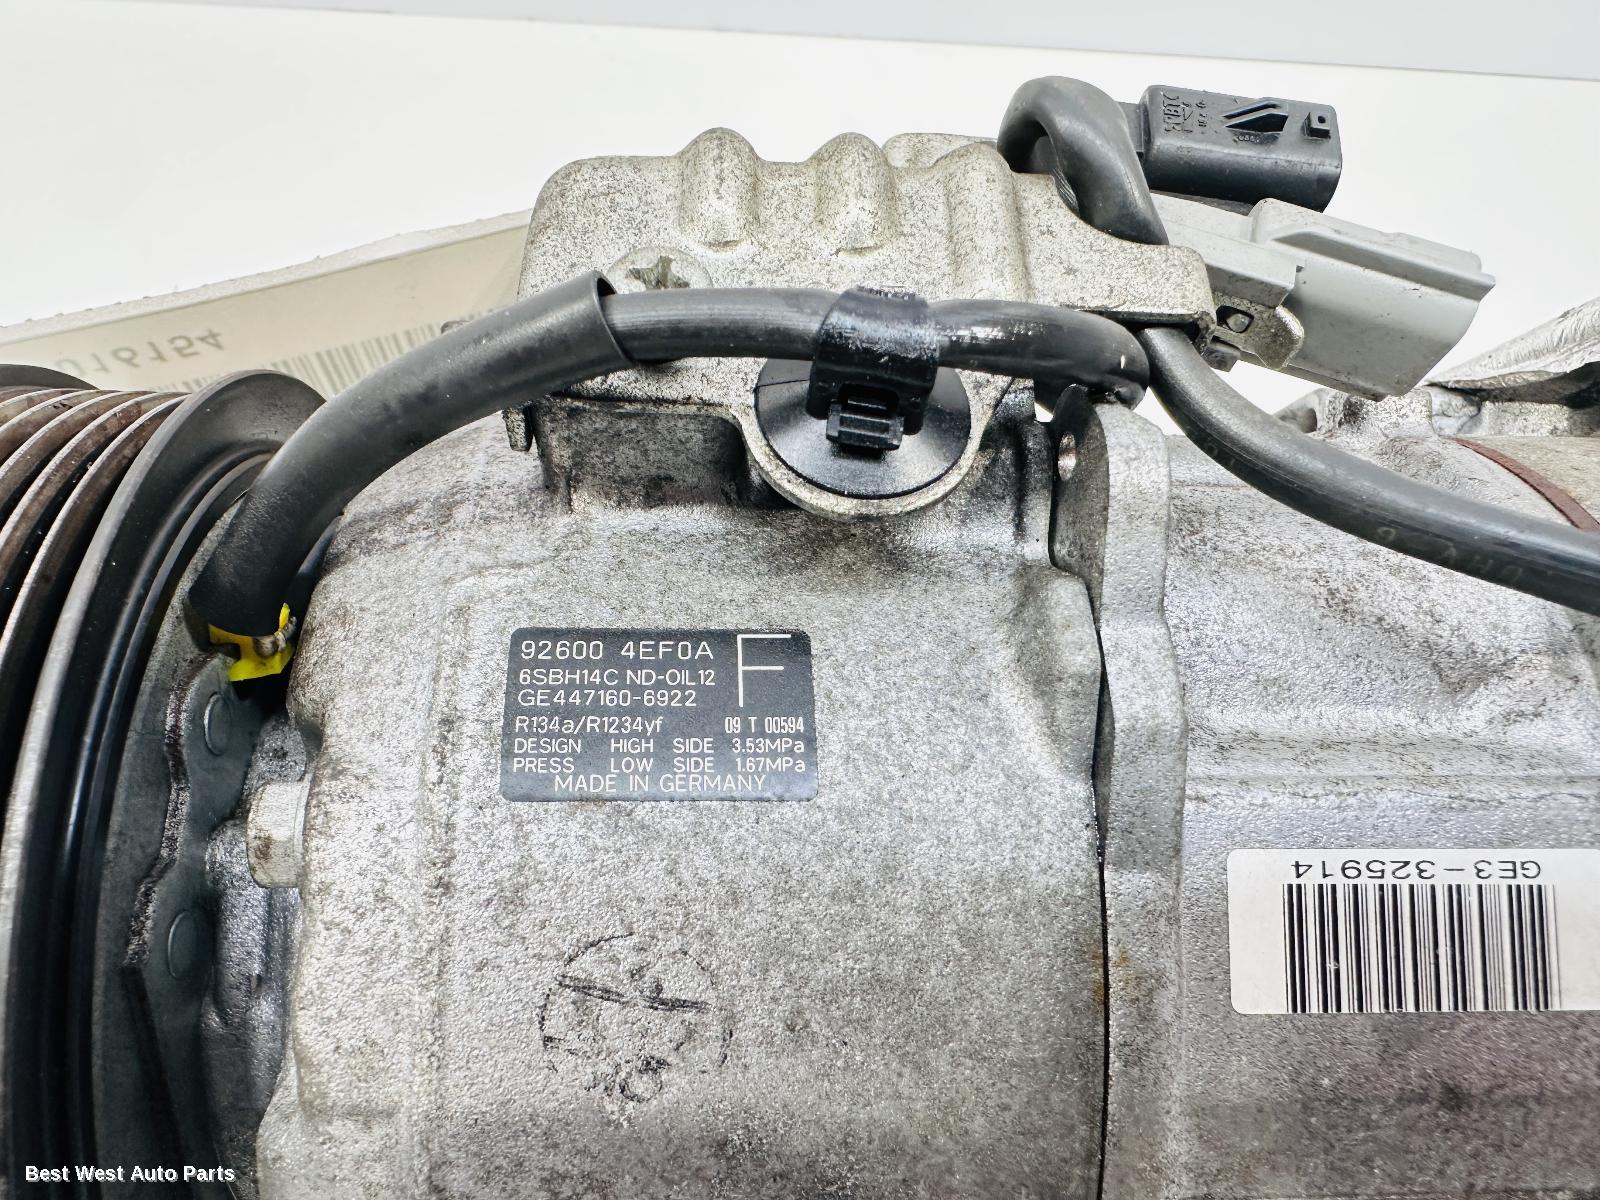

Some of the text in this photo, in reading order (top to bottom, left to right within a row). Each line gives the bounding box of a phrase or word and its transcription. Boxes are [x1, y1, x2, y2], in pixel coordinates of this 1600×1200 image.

[521, 641, 603, 660] 92600
[519, 669, 619, 685] 6SBH14C
[737, 634, 792, 707] F
[518, 689, 697, 706] GE447160-6922
[515, 716, 663, 736] R134a/R1234yf
[725, 717, 804, 733] 09 T 00594
[514, 738, 804, 754] DESIGN HIGH SIDE 3.53MPa
[513, 757, 806, 773] PRESS LOW SIDE 1.67MPa
[554, 775, 766, 792] MADE IN GERMANY
[1291, 859, 1542, 880] GE3-325914
